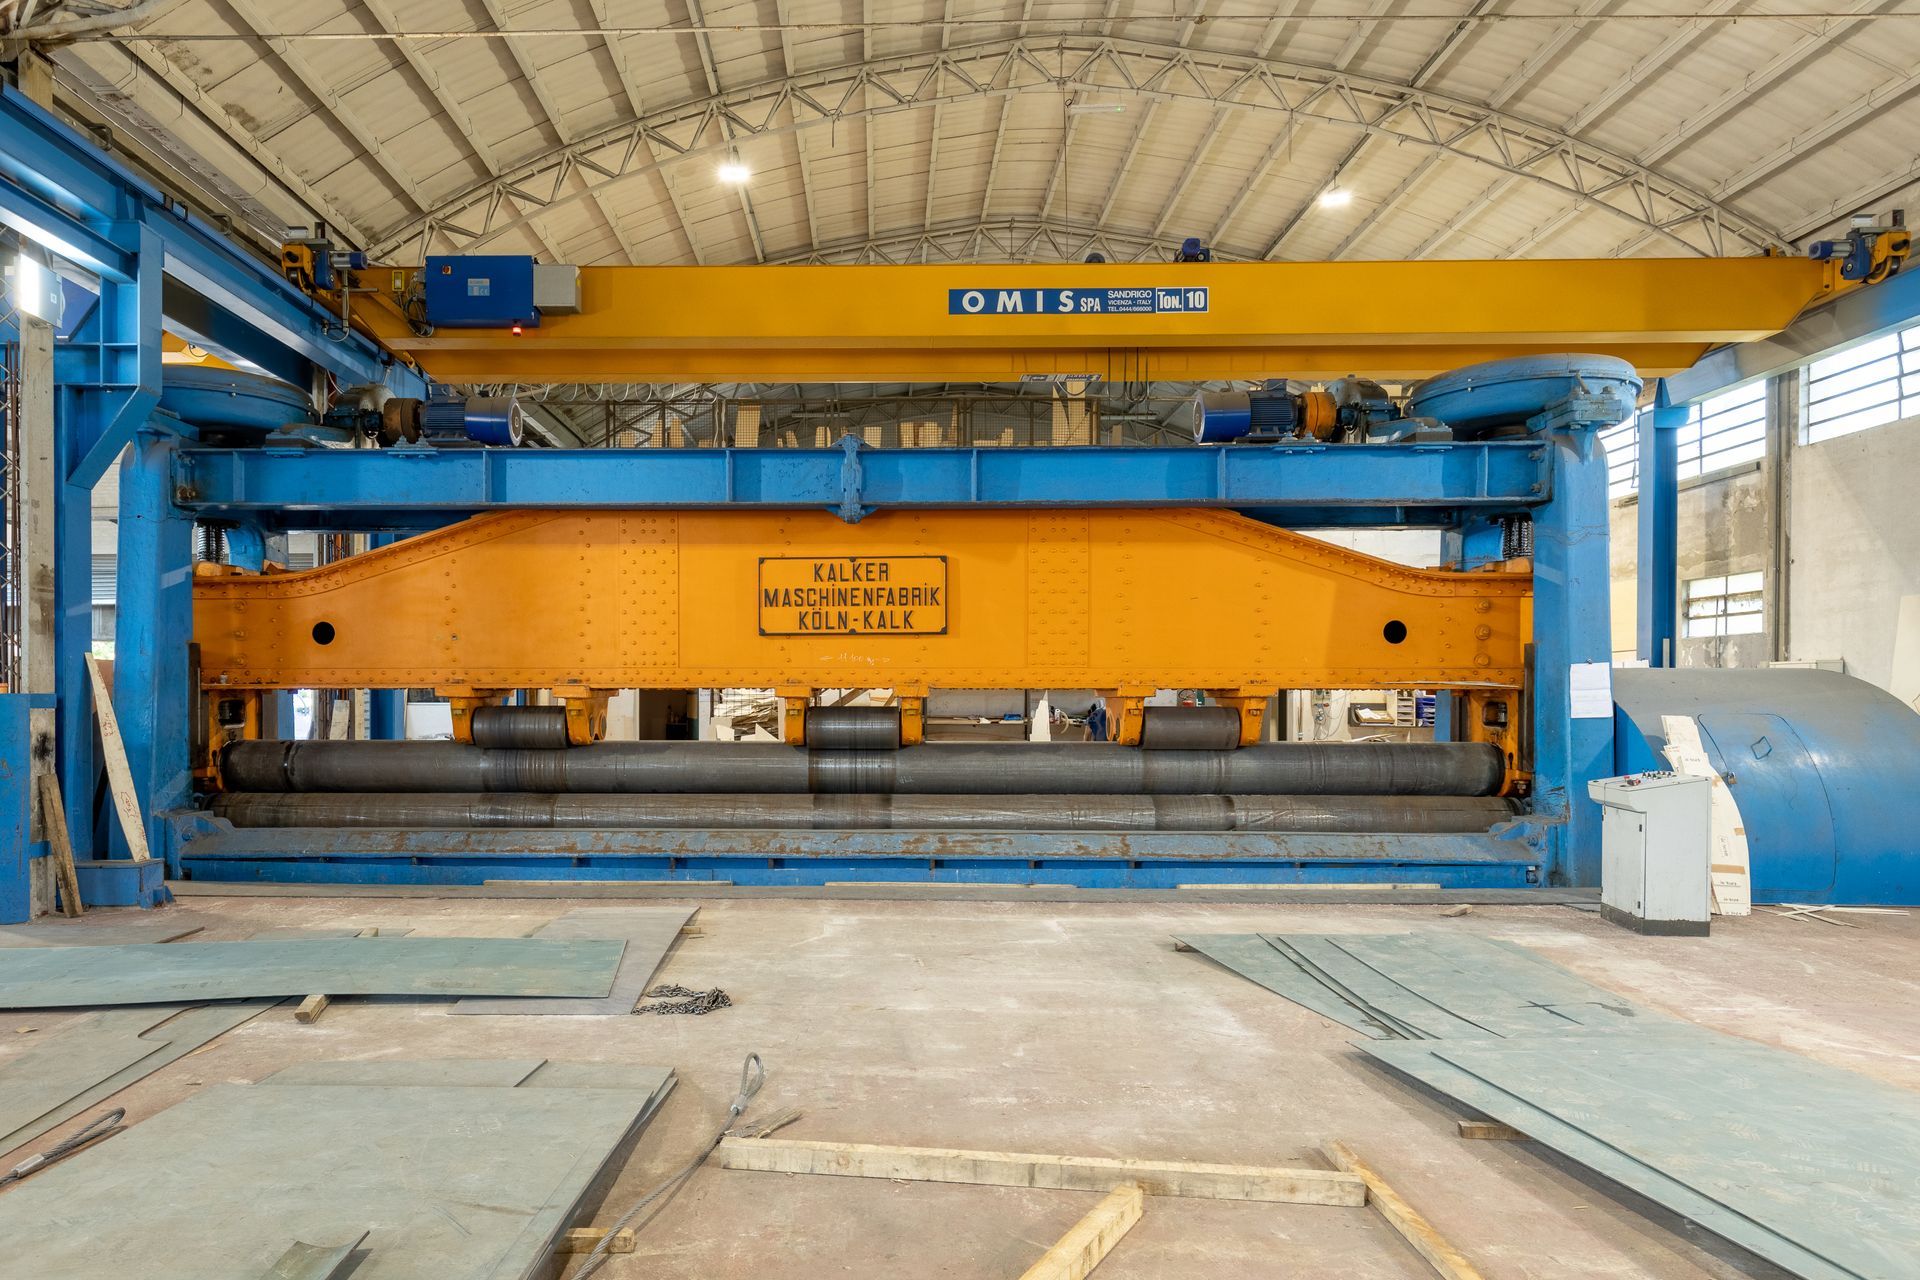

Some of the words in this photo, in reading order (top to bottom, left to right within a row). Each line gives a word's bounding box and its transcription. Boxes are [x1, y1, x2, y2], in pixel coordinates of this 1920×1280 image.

[962, 290, 1075, 313] OMIS
[1080, 297, 1101, 312] SPA
[1107, 290, 1152, 299] SANDRIGO
[1186, 291, 1204, 308] 10
[814, 563, 889, 582] KALKER
